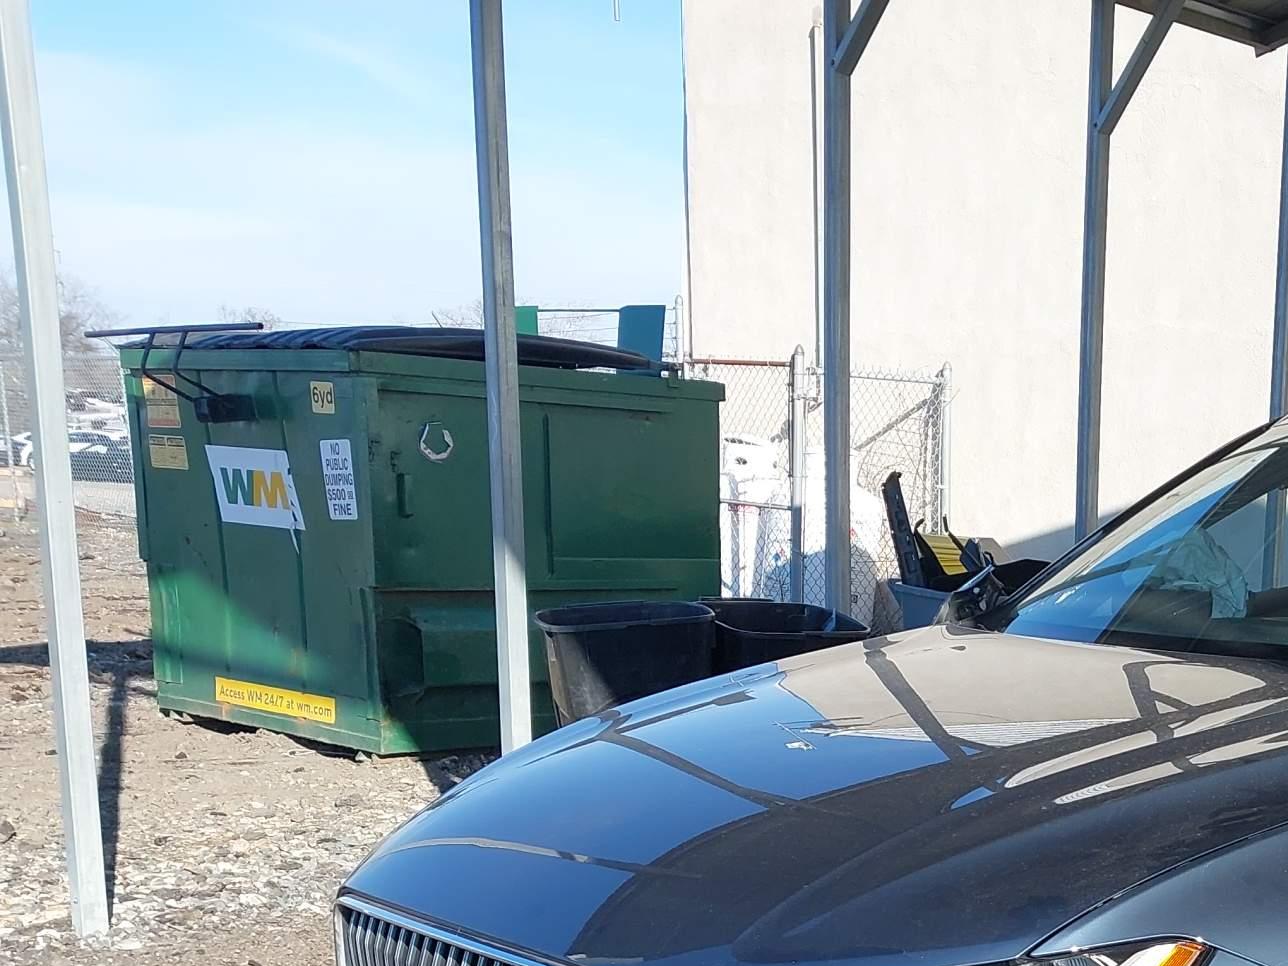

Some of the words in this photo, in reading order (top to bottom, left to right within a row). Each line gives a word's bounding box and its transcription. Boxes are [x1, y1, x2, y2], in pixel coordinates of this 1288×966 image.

[312, 386, 333, 408] 6yd
[330, 442, 340, 455] NO
[326, 458, 348, 471] PUBLIC
[325, 473, 353, 486] DUMPING
[220, 467, 291, 510] WM
[333, 503, 352, 516] FINE
[220, 684, 245, 700] Access
[247, 689, 262, 702] WM
[264, 693, 284, 707] 24/7
[286, 700, 294, 710] at
[296, 703, 332, 717] wm.com
